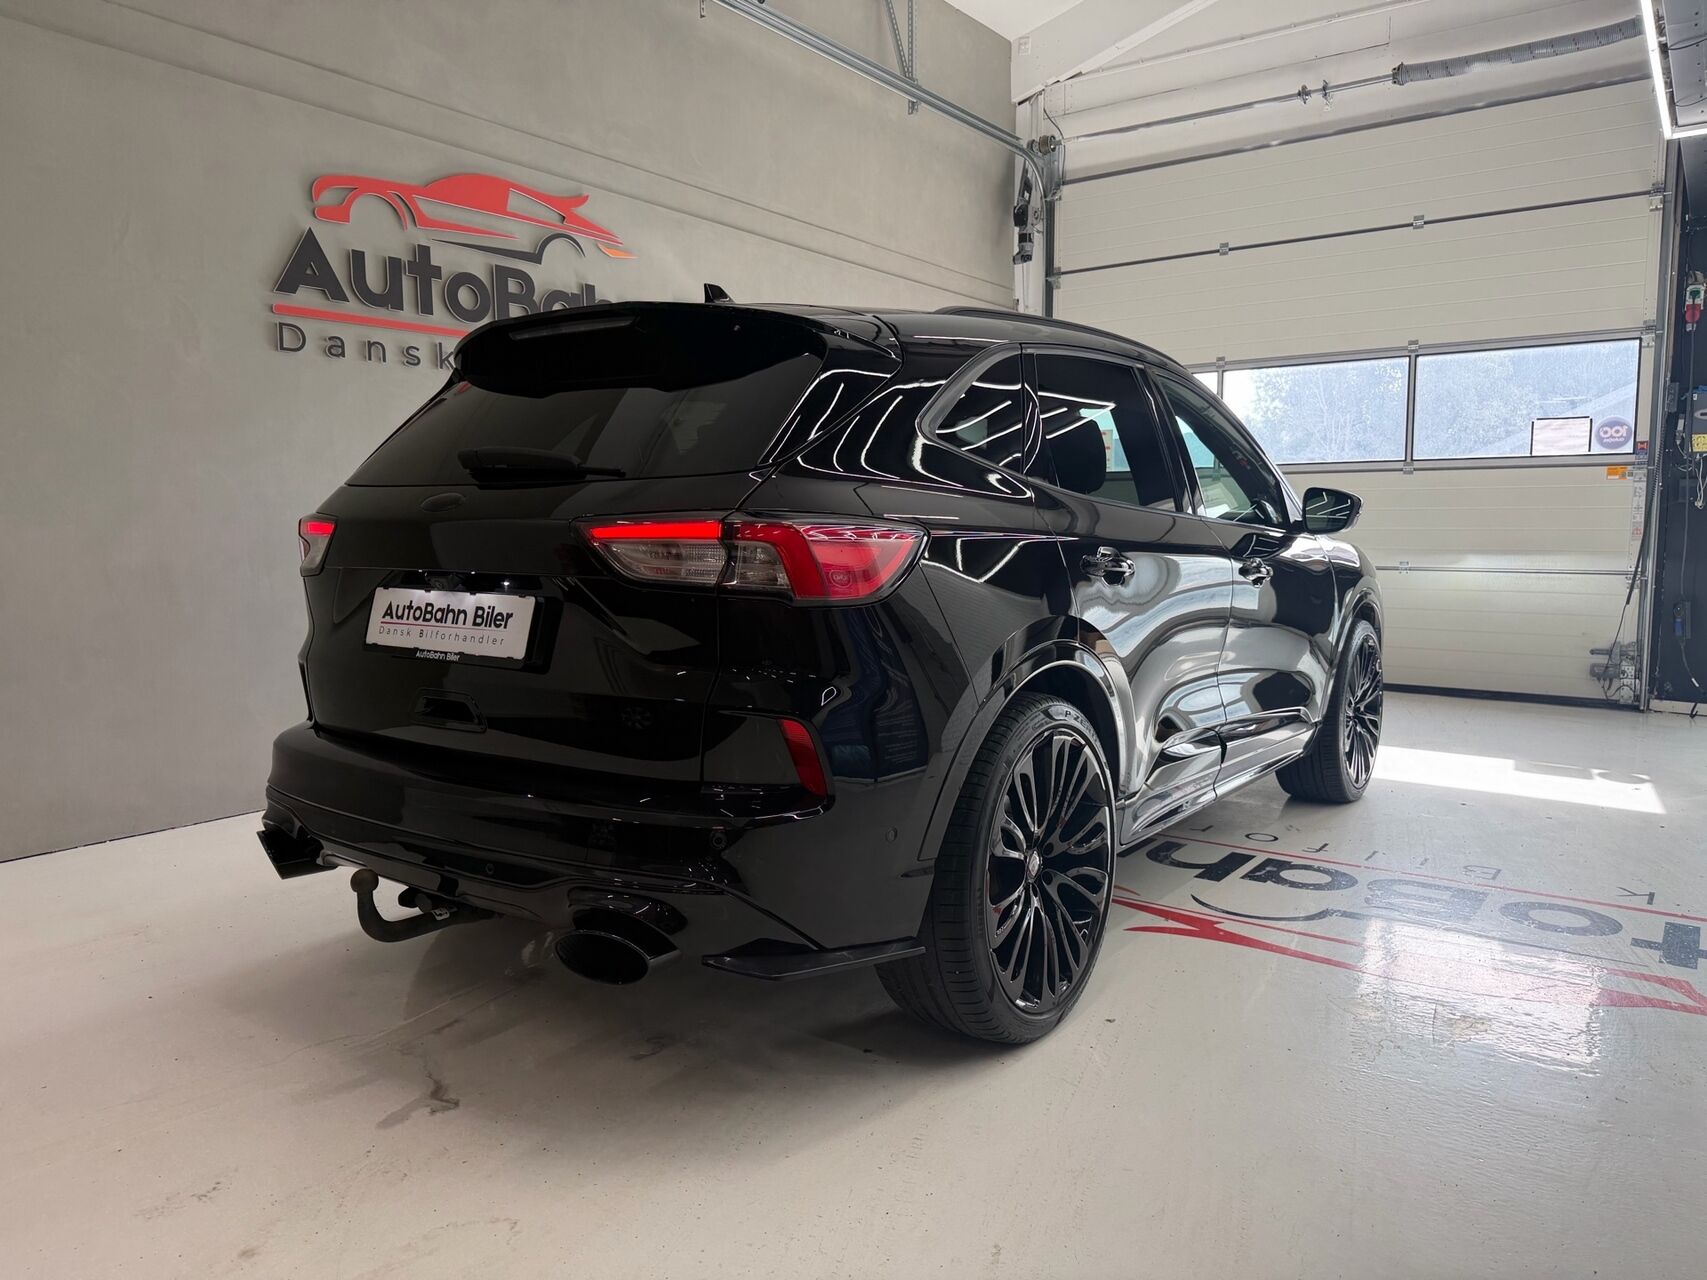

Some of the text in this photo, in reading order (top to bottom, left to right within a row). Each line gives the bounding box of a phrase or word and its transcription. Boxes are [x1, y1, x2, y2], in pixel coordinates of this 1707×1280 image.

[276, 321, 455, 370] Dansk
[381, 600, 514, 629] AutoBahn Biler
[378, 625, 505, 646] Dansk Bilforhandler
[415, 650, 461, 662] AutoBahn Biler
